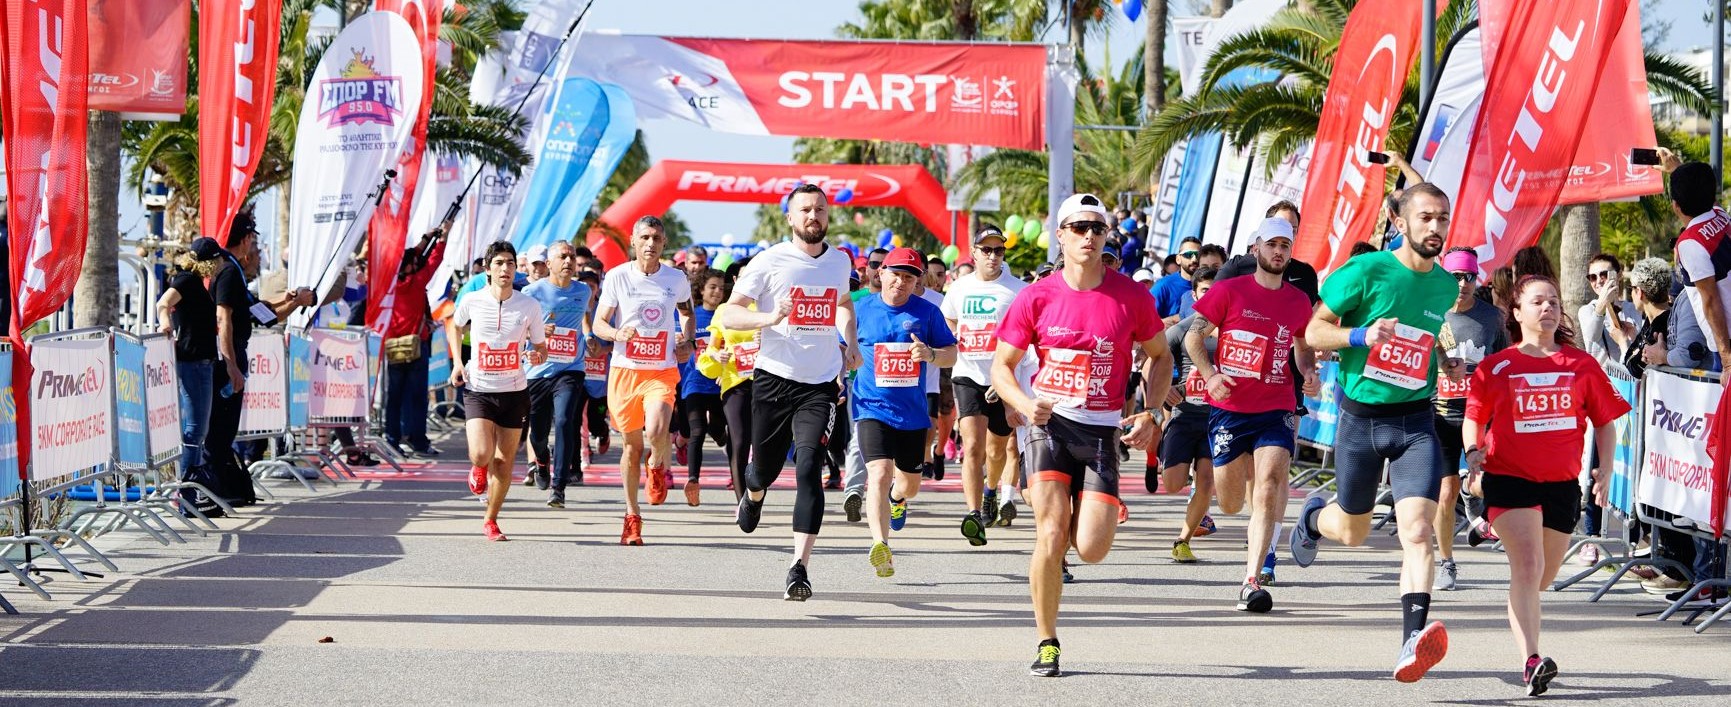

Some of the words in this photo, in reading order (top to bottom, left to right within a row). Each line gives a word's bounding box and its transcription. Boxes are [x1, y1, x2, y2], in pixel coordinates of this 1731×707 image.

[319, 80, 368, 115] ΣΠΟΡ
[372, 79, 402, 114] FM
[777, 71, 948, 114] START
[797, 304, 831, 319] 9480
[632, 342, 661, 355] 7888
[1222, 345, 1262, 366] 12957
[1379, 343, 1423, 370] 6540
[480, 354, 517, 367] 10519
[881, 359, 914, 372] 8769
[1091, 365, 1112, 376] 2018
[37, 366, 99, 400] PRIMETEL
[1088, 379, 1109, 396] 5K
[1516, 393, 1572, 414] 14318
[37, 426, 53, 450] 5KM
[54, 418, 92, 447] CORPORATE
